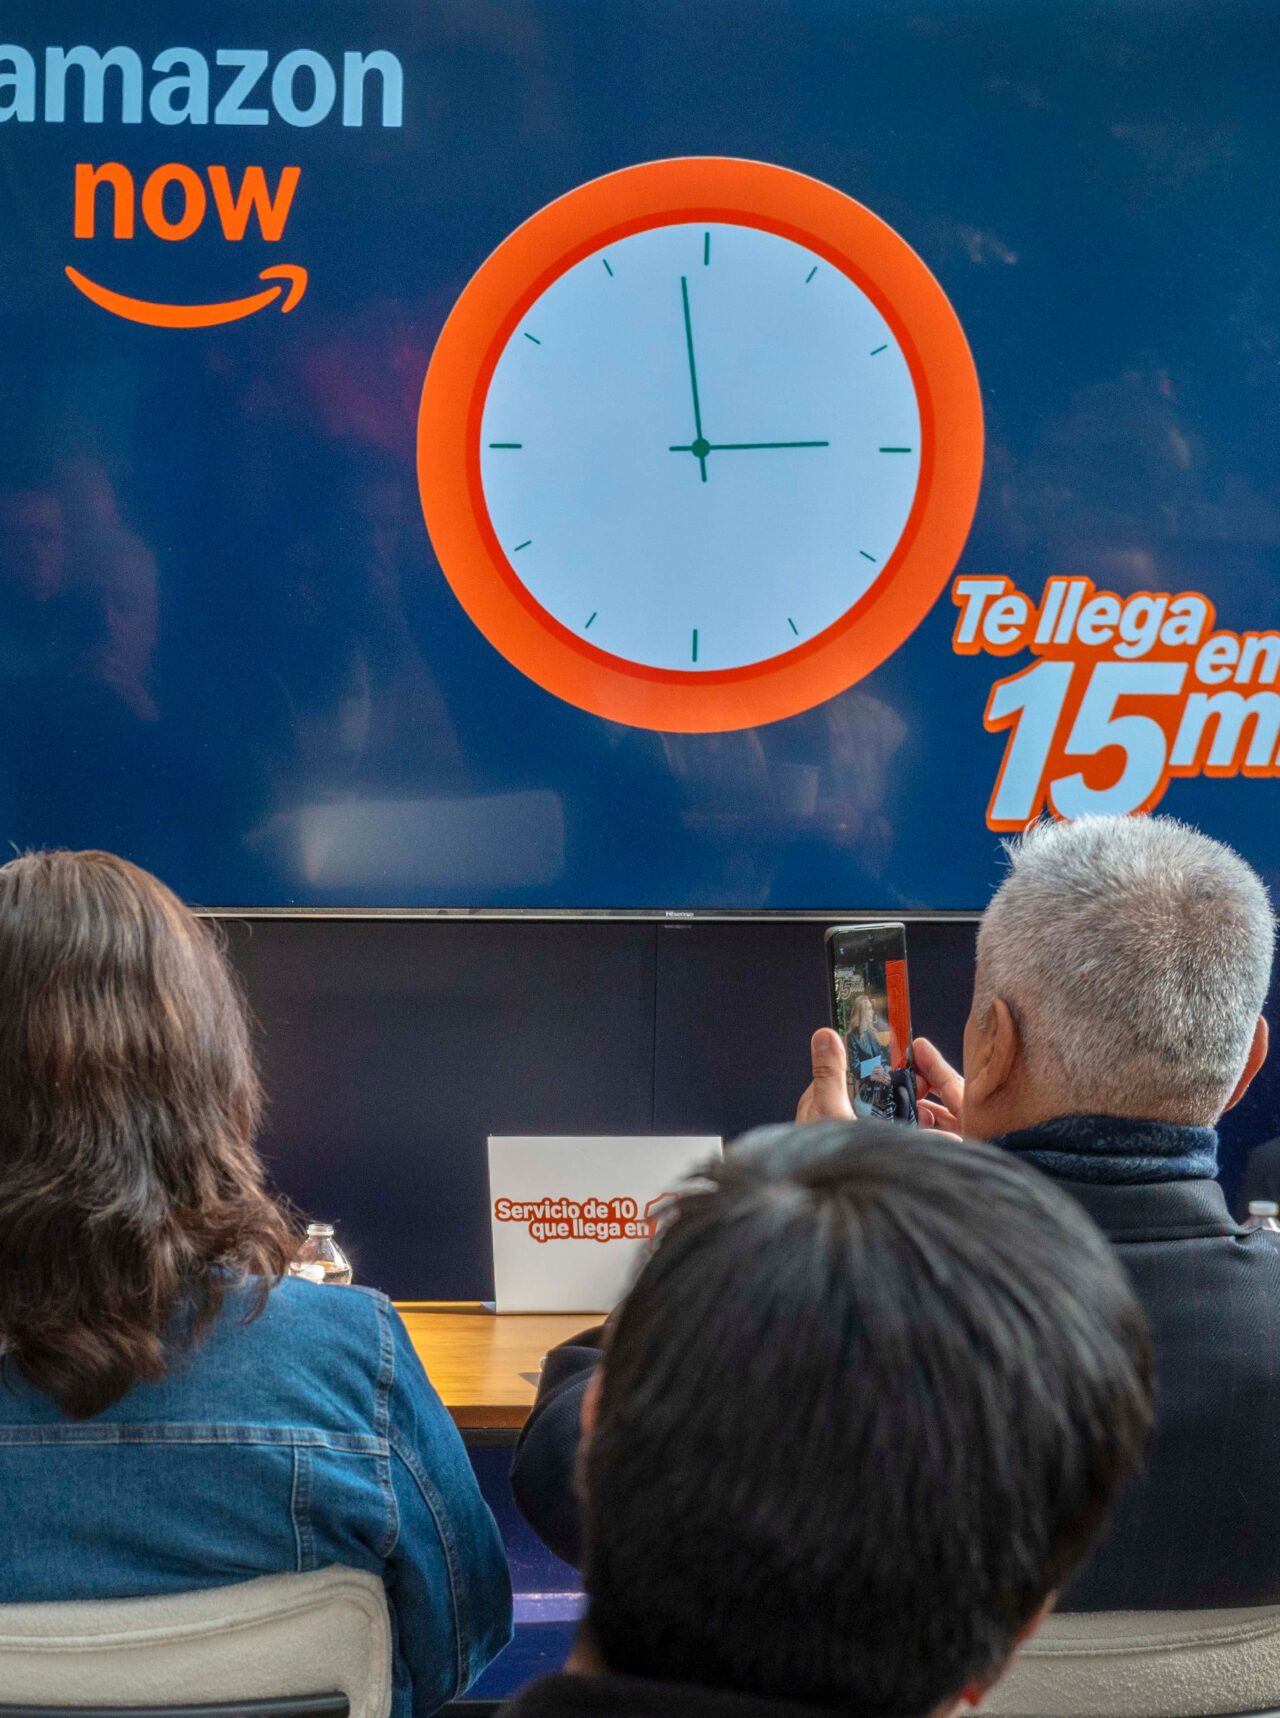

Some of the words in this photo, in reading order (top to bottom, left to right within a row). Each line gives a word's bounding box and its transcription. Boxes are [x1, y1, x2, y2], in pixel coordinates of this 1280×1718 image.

[74, 162, 301, 242] now
[955, 579, 1028, 646] Te
[1033, 580, 1208, 659] llega
[1194, 633, 1280, 686] en
[987, 660, 1189, 822] 15
[1168, 690, 1280, 767] m
[496, 1199, 581, 1219] Servicio
[583, 1199, 609, 1219] de
[611, 1199, 635, 1219] 10
[531, 1221, 570, 1240] que
[572, 1218, 621, 1240] llega
[624, 1221, 650, 1237] en
